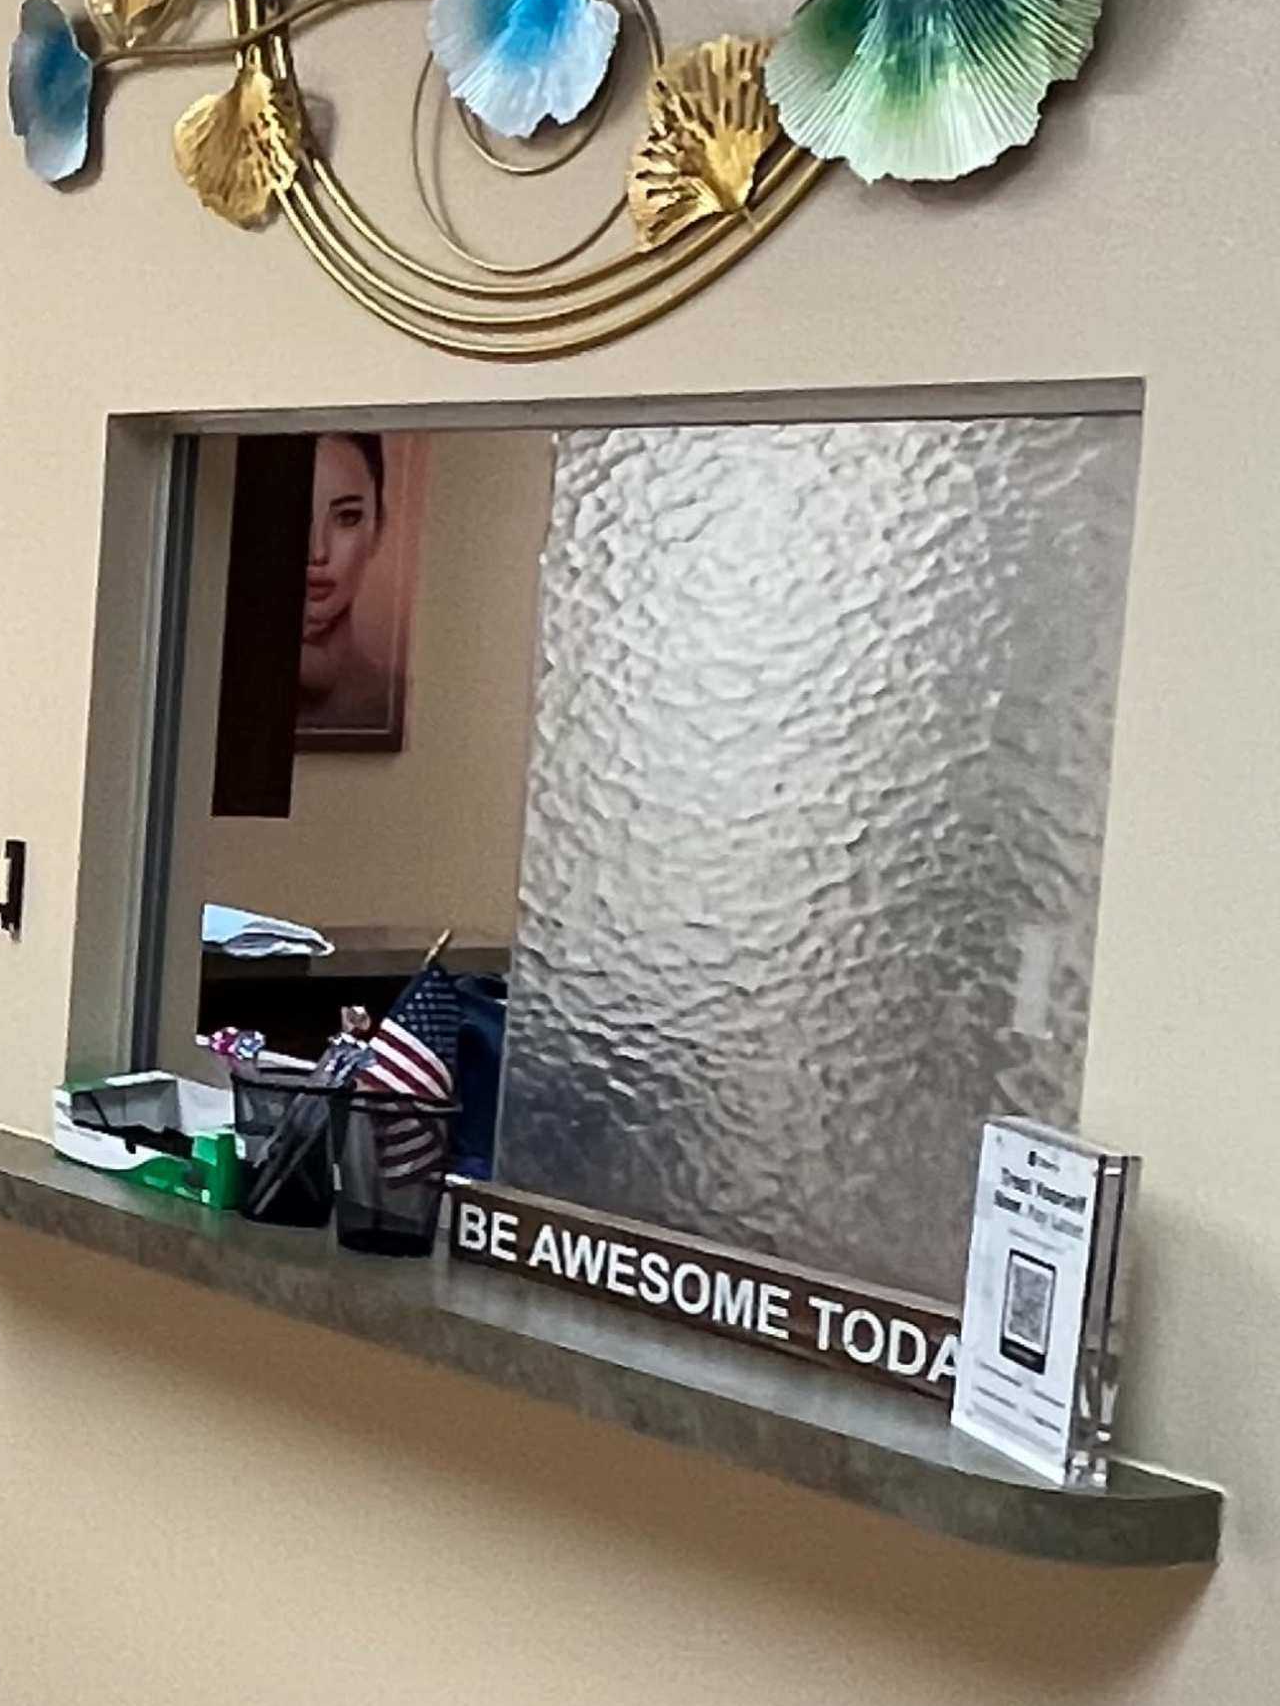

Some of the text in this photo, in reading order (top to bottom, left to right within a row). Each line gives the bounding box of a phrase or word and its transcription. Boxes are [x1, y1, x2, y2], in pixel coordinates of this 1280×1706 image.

[458, 1201, 962, 1383] BE AWESOME TODA
